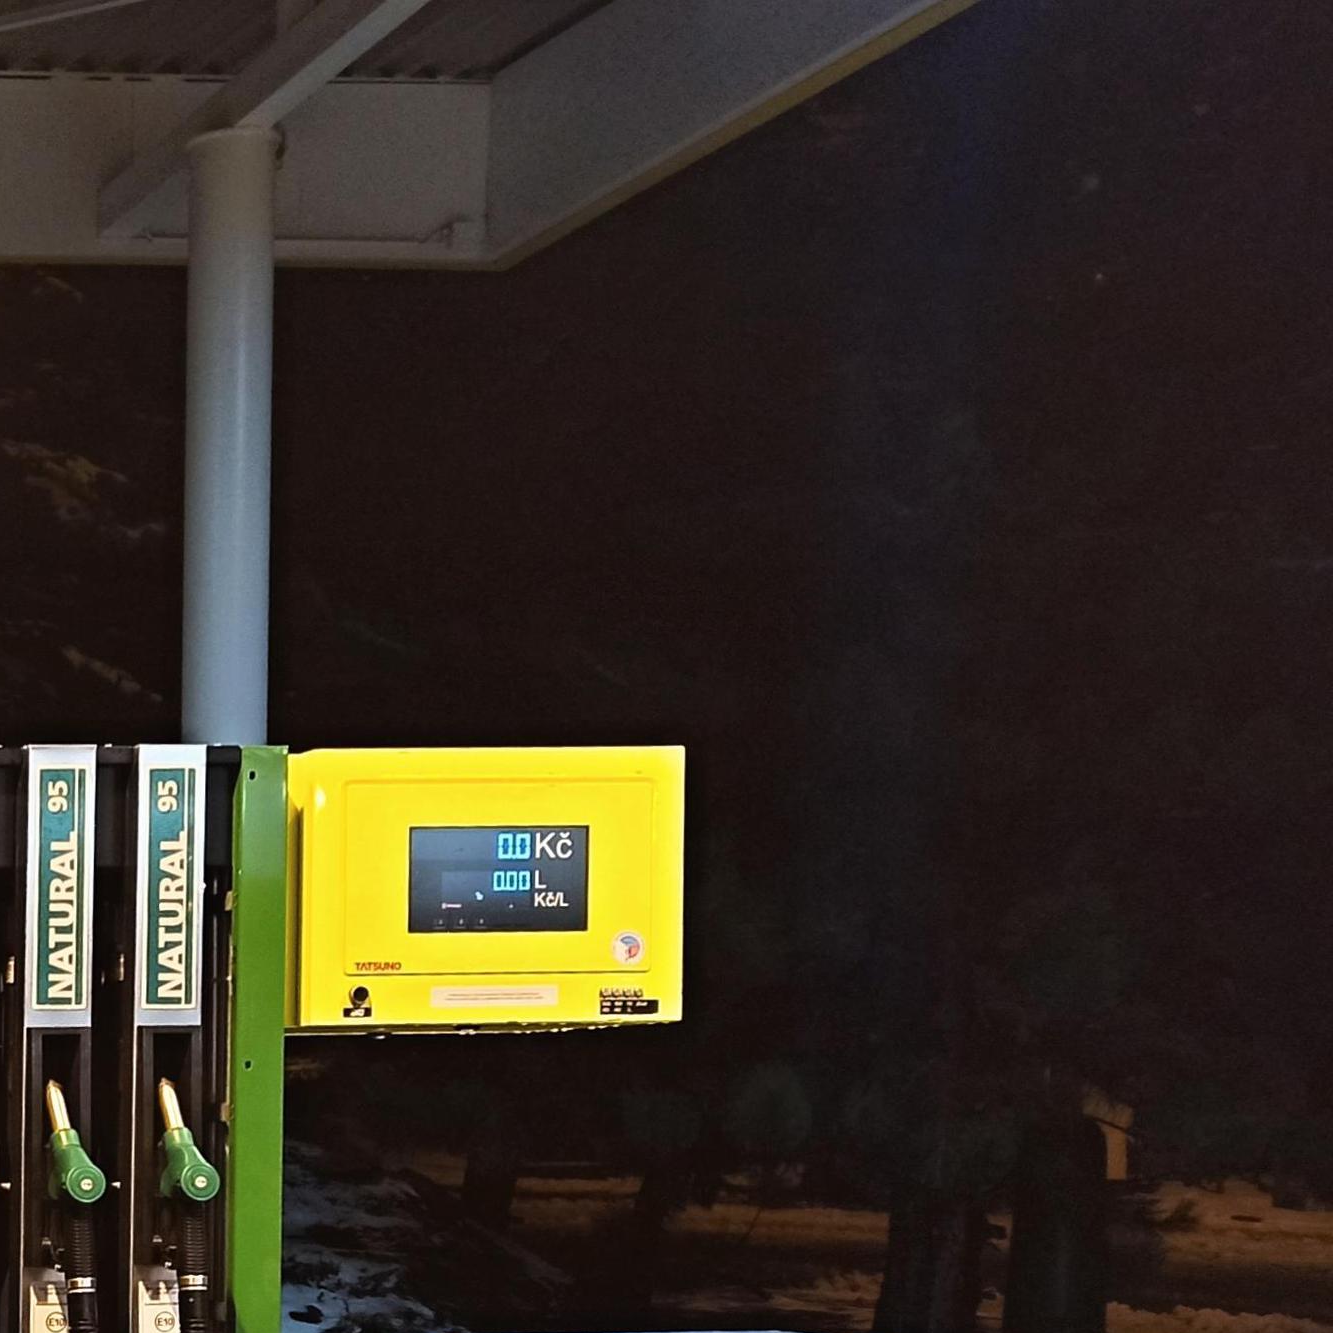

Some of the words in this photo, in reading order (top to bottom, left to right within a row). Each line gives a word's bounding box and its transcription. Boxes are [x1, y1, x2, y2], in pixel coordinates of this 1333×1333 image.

[48, 780, 69, 813] 95
[158, 779, 178, 813] 95
[535, 831, 573, 859] Kč
[535, 869, 547, 889] L
[534, 891, 569, 907] Kč/L
[48, 831, 77, 1000] NATURAL
[157, 831, 186, 1000] NATURAL
[355, 961, 402, 971] TATSUNO
